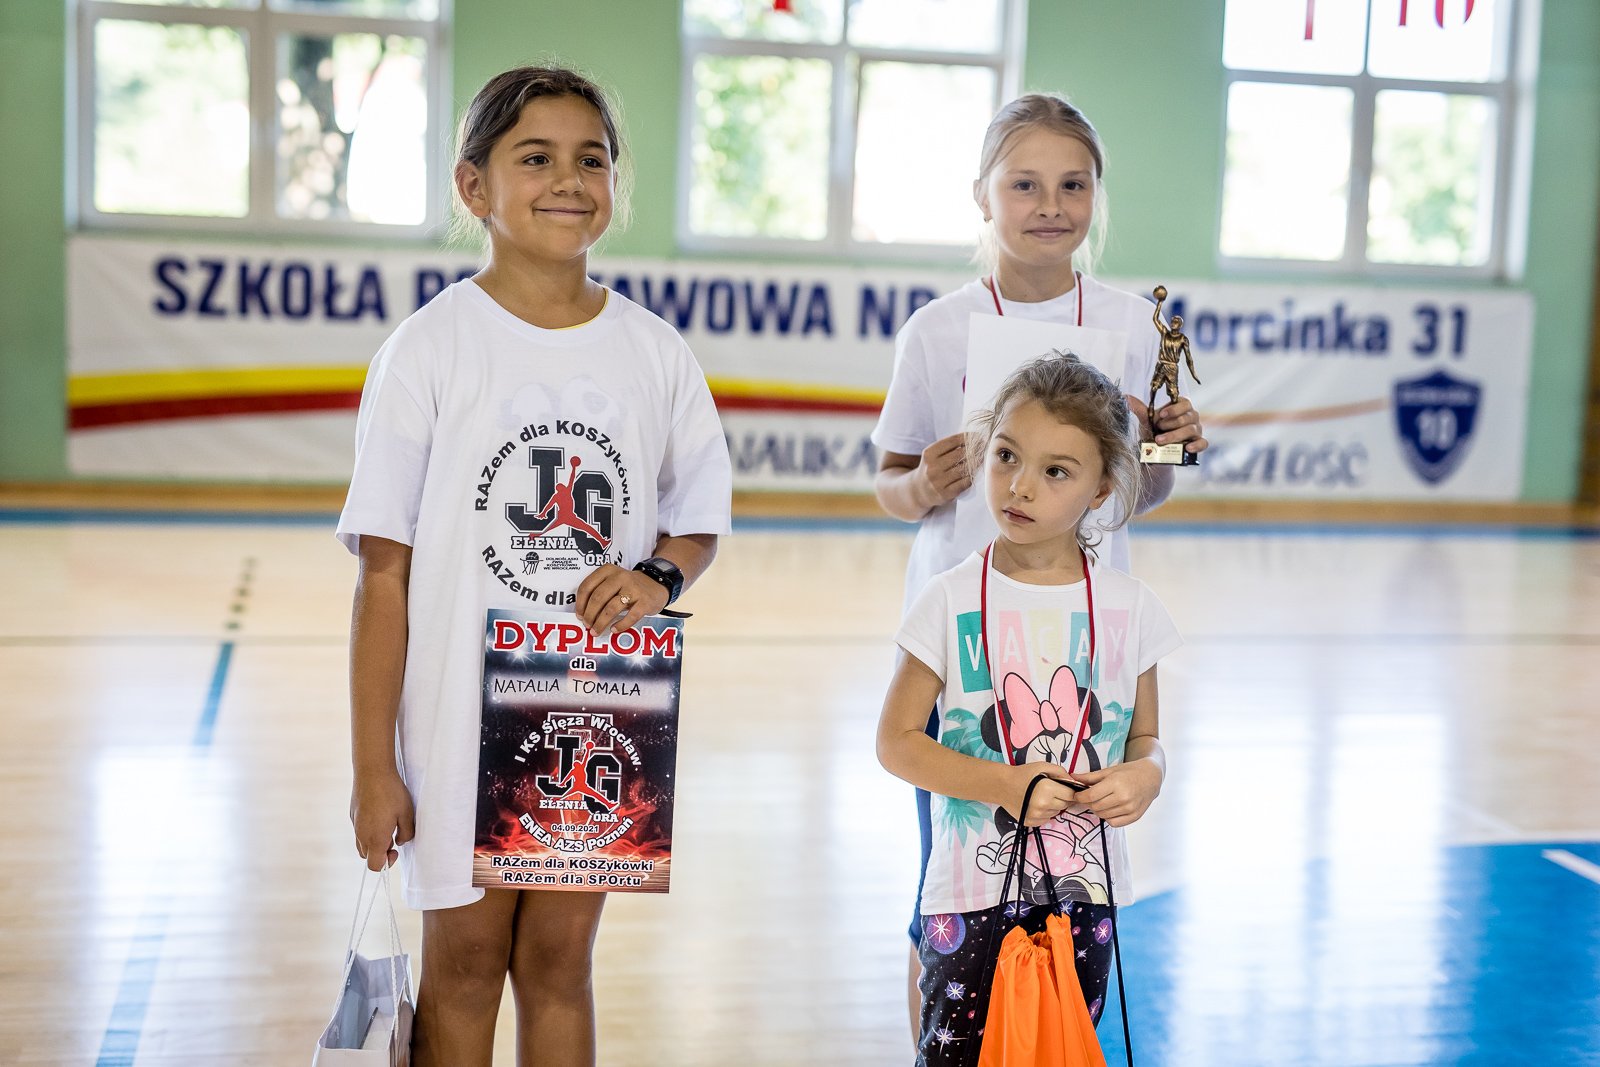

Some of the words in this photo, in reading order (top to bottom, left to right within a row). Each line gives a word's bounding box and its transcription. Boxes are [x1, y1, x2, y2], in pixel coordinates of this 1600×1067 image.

[152, 255, 387, 324] SZKOŁA
[416, 269, 835, 338] PWOWA
[1411, 305, 1467, 358] 31
[475, 440, 517, 511] RAZem
[519, 424, 549, 443] dla
[556, 420, 630, 515] KOSZykówki
[511, 536, 579, 550] ELENIA
[482, 545, 539, 601] RAZem
[545, 591, 577, 606] dla
[493, 619, 677, 657] DYPLOM
[965, 625, 1123, 672] VACAY
[570, 657, 596, 671] dla
[494, 678, 560, 694] NATALIA
[572, 678, 641, 696] TOMALA
[520, 731, 541, 754] KS
[541, 714, 585, 736] Ślęza
[590, 714, 642, 767] Wrocław
[539, 799, 589, 811] ELENIA
[592, 809, 619, 823] ÓRA
[518, 812, 553, 846] ENEA
[553, 838, 585, 852] AZS
[585, 816, 634, 852] Poznań
[551, 824, 599, 833] 04.09.2021
[492, 856, 541, 869] RAZem
[543, 857, 565, 870] dla
[568, 857, 654, 872] KOSZykówki
[503, 872, 556, 885] RAZem
[560, 873, 584, 885] dla
[588, 874, 642, 887] SPOrtu
